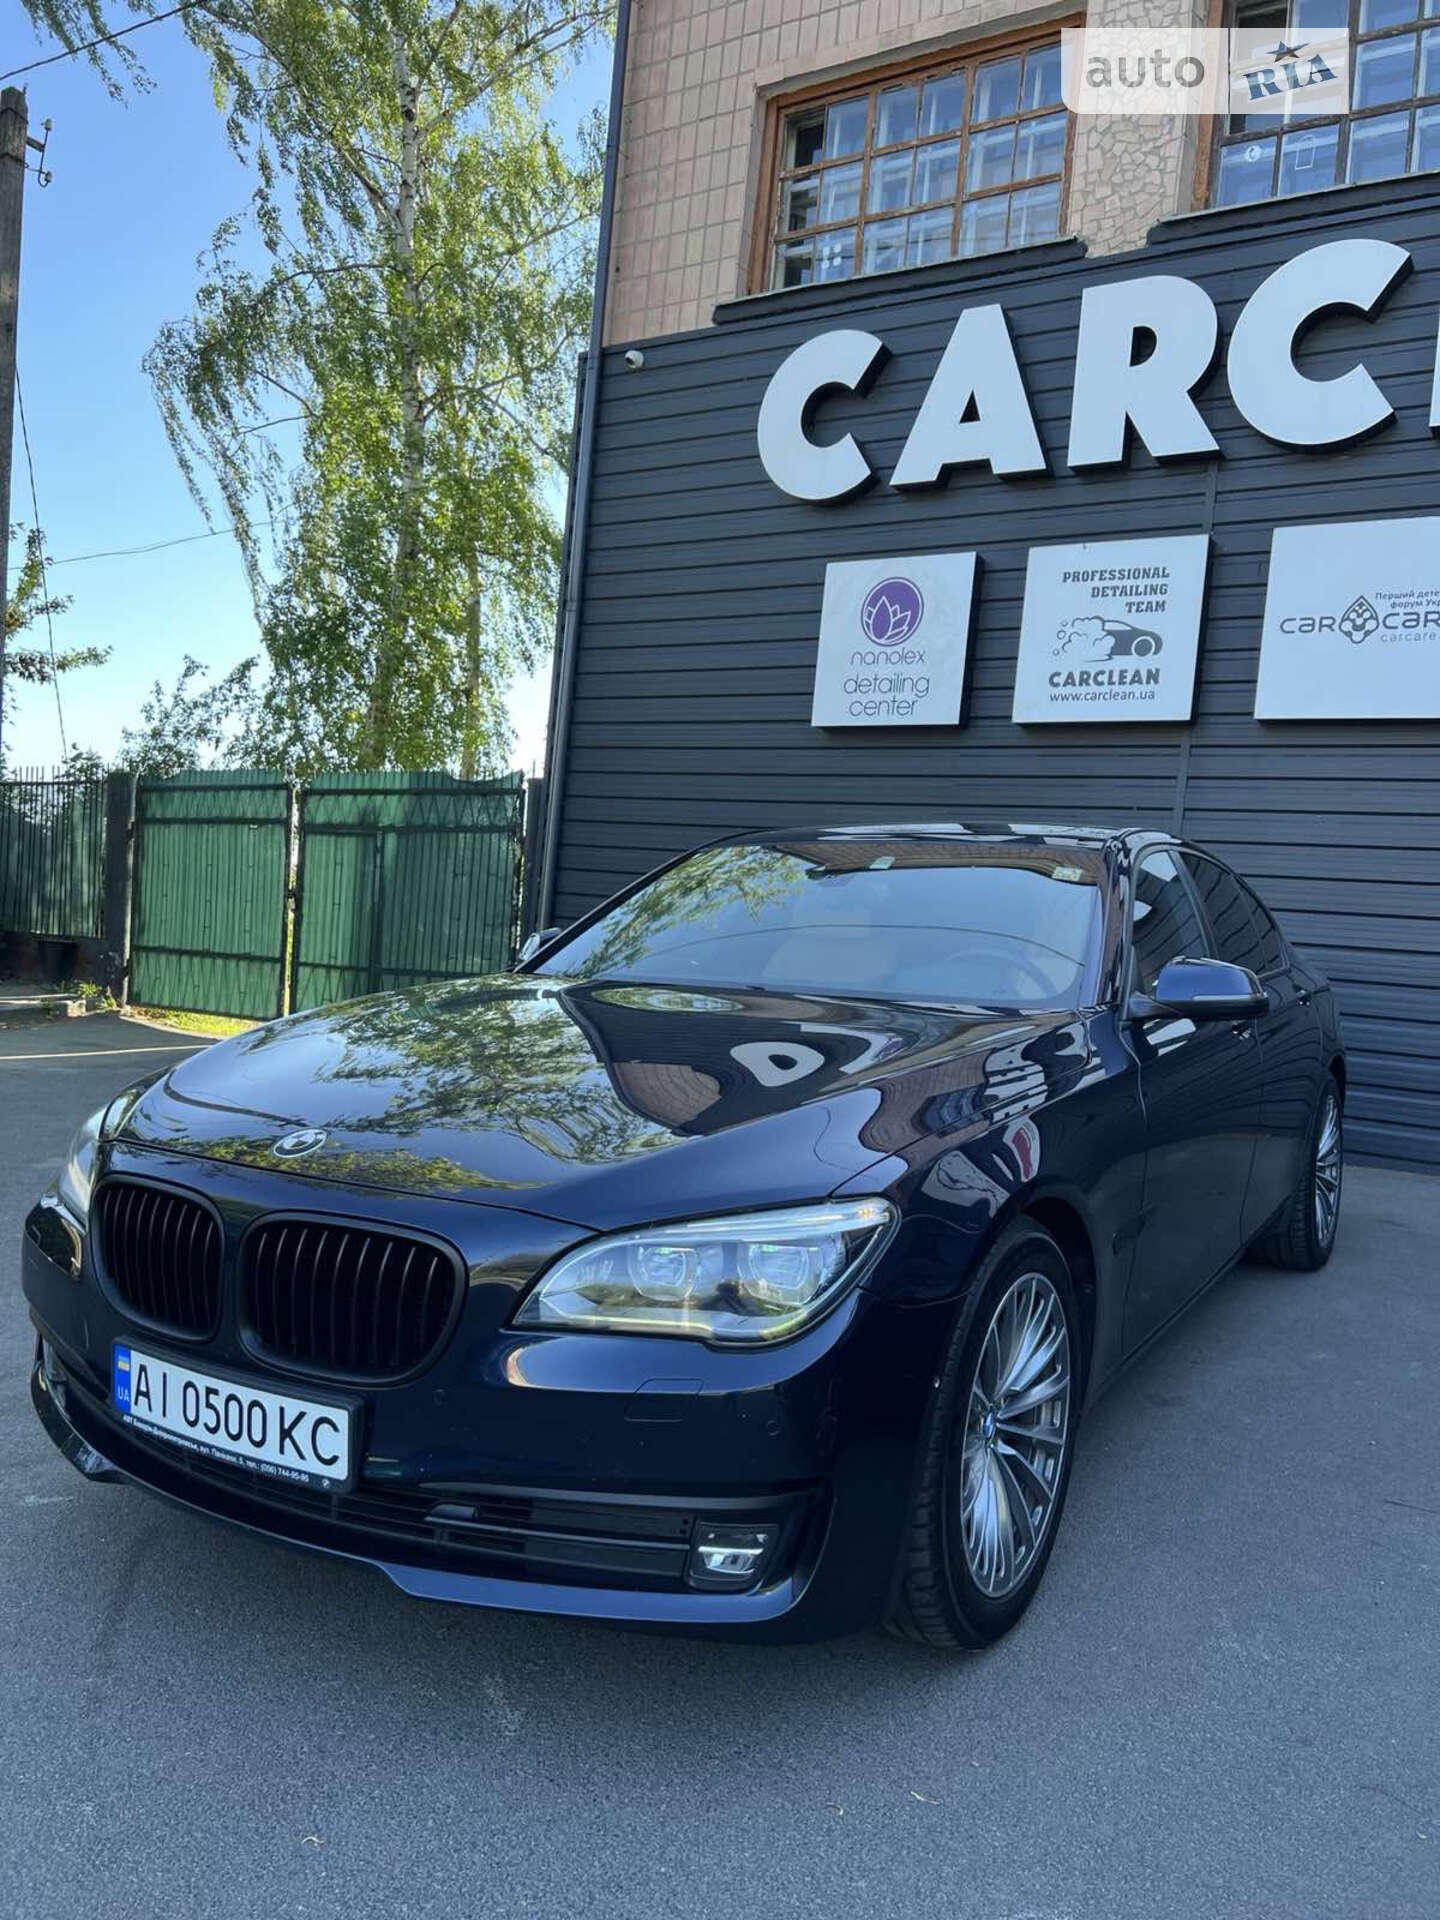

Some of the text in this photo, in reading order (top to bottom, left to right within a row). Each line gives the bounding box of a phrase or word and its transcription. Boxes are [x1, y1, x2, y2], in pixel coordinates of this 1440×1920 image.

[757, 238, 1440, 500] CARC
[1062, 566, 1170, 583] PROFESSIONAL
[1090, 583, 1168, 598] DETAILING
[1375, 590, 1415, 600] Перший
[1125, 600, 1166, 614] TEAM
[1390, 600, 1423, 609] форум
[1380, 632, 1440, 642] carcare
[850, 647, 926, 666] nanolex
[843, 673, 930, 698] detailing
[1049, 668, 1160, 688] CARCLEAN
[1049, 689, 1155, 702] www.carclean.ua
[849, 695, 918, 717] center
[117, 1385, 130, 1402] UA
